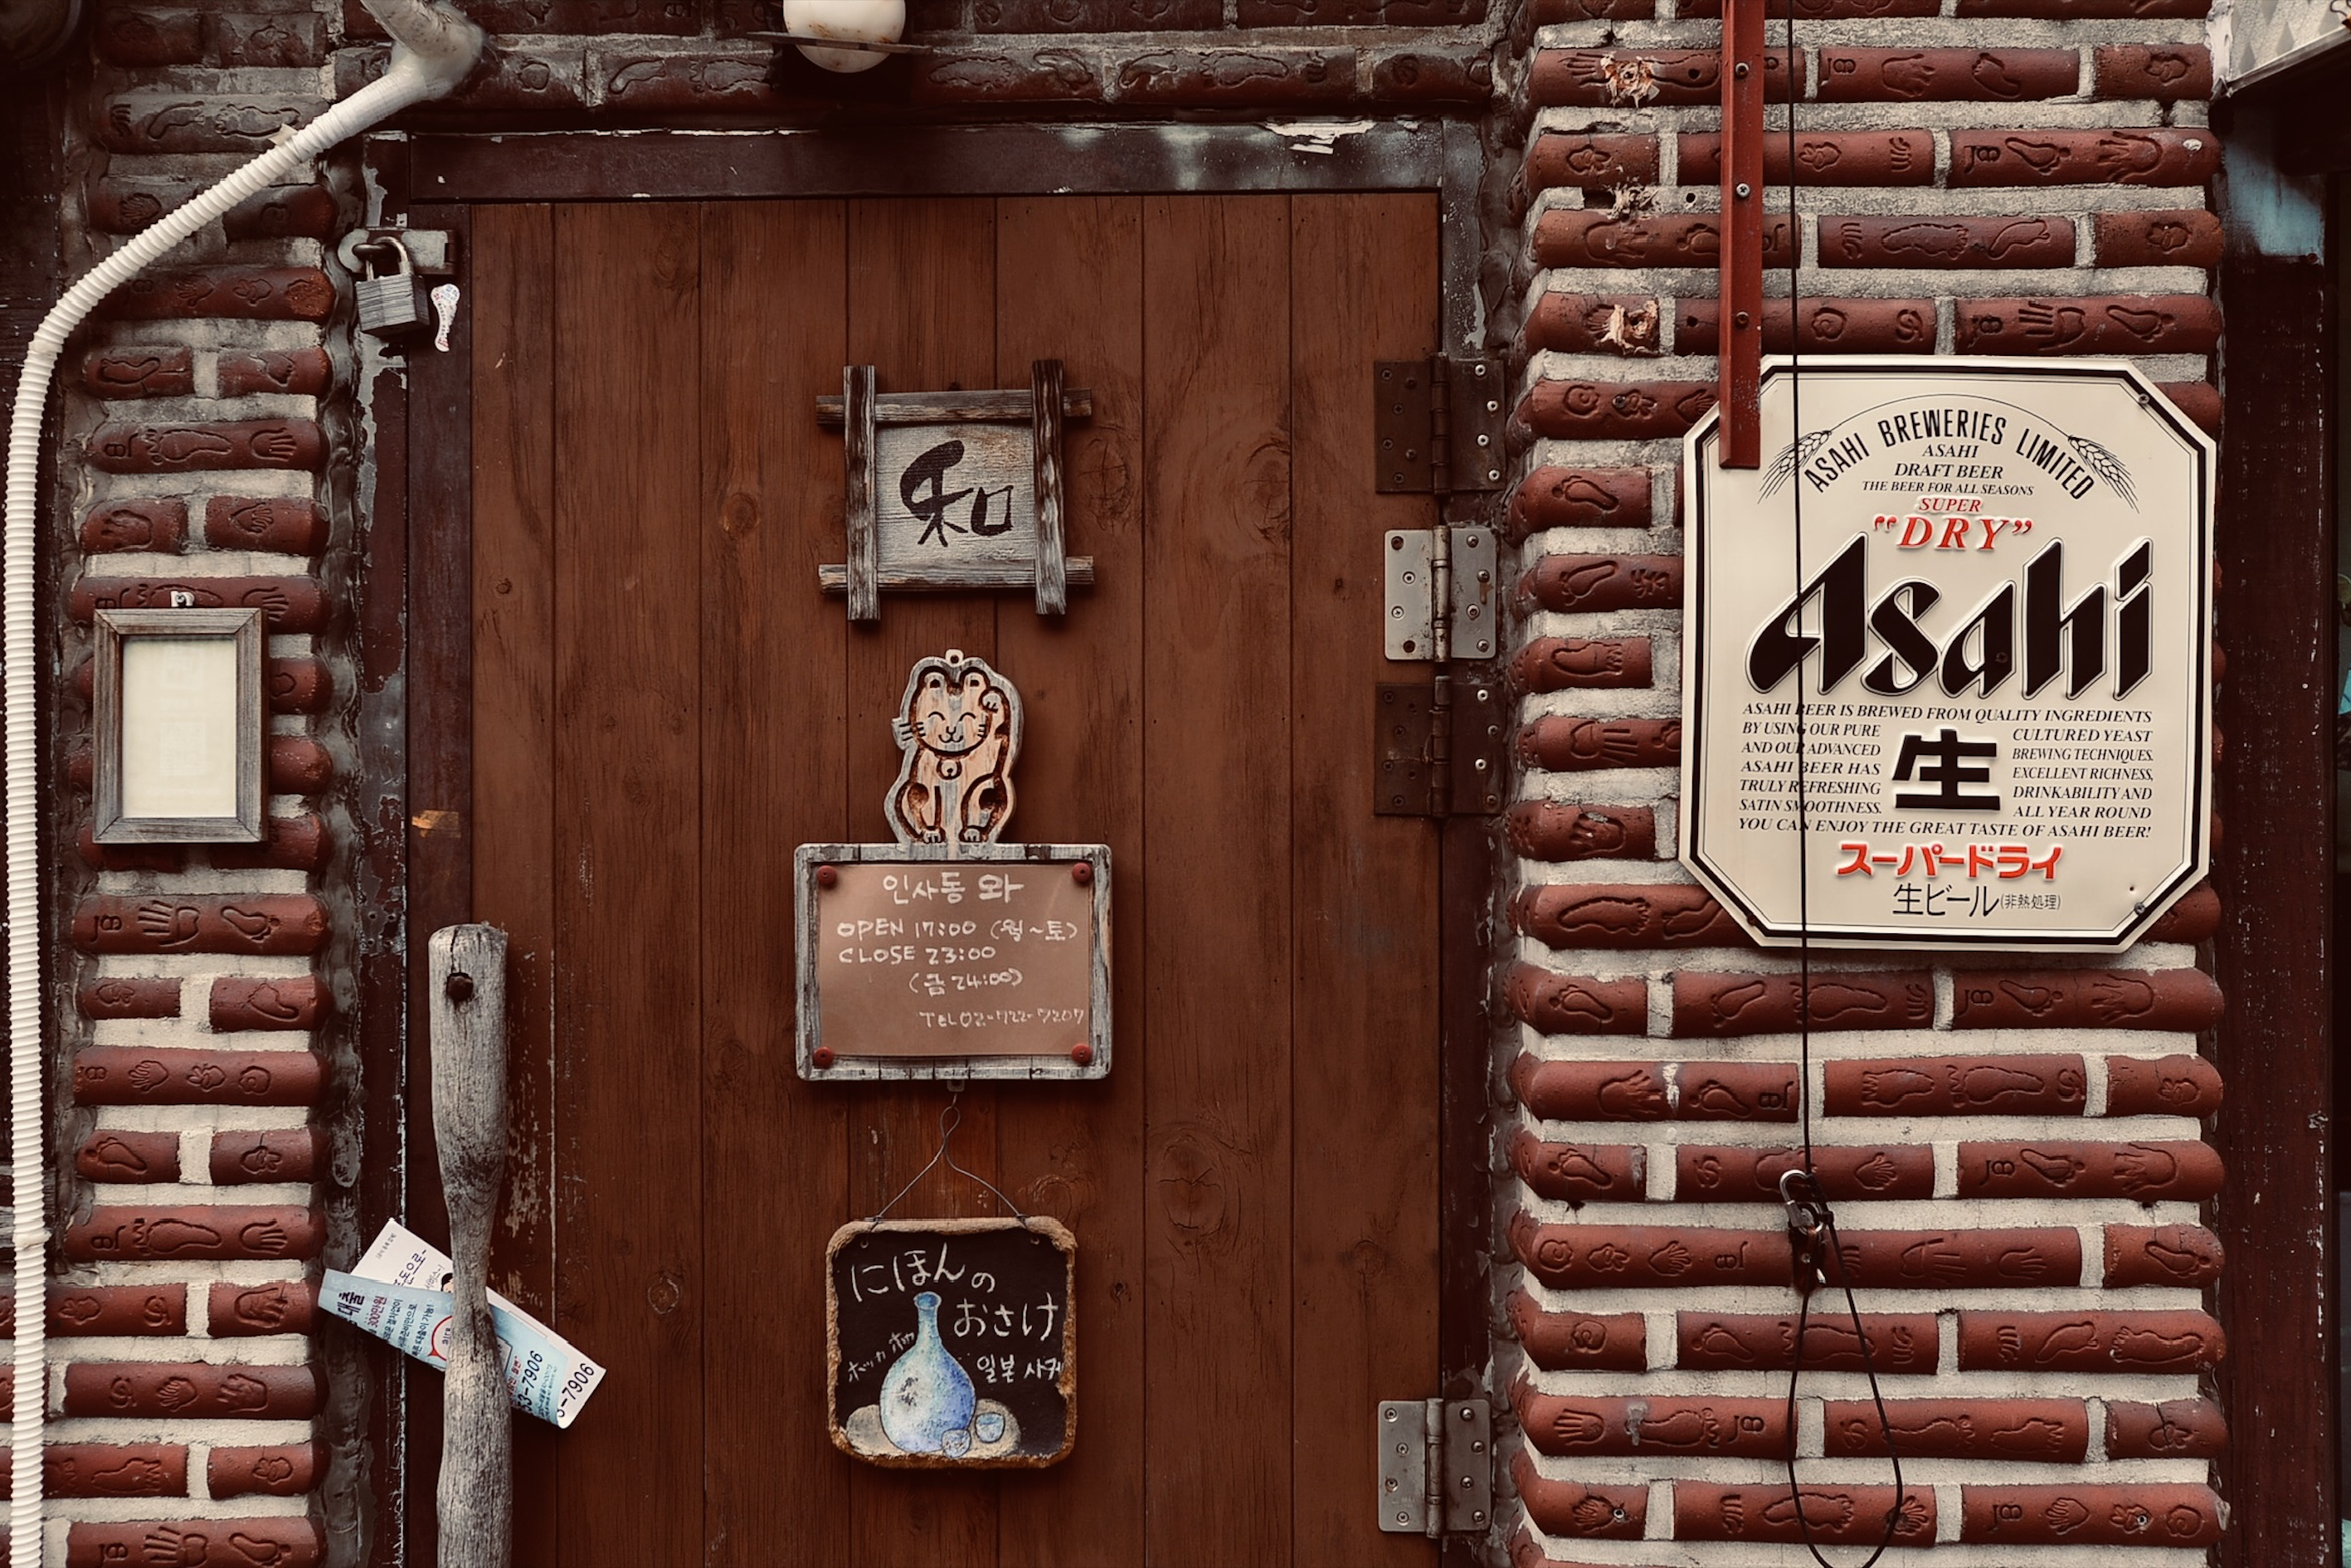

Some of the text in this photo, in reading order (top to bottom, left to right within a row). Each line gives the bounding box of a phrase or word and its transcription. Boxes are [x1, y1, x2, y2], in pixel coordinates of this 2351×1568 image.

[1803, 409, 2095, 499] ASAHI BREWERIES LIMITED
[1922, 444, 1979, 458] ASAHI
[1894, 463, 2003, 479] DRAFT BEER
[899, 440, 1014, 548] 和
[1862, 480, 2034, 496] THE BEER FOR ALL SEASONS
[1918, 498, 1981, 513] SUPER
[1746, 532, 2153, 700] Asahi
[1742, 703, 2152, 723] ASAHI BEER IS BREWED FROM QUALITY INGREDIENTS
[1742, 721, 1881, 737] BY USING OUR PURE
[2013, 728, 2153, 742] CULTURED YEAST
[1741, 742, 1772, 753] AND
[1807, 743, 1881, 756] ADVANCED
[2012, 747, 2071, 760] BREWING
[1740, 760, 1881, 775] ASAHI BEER HAS
[1891, 728, 2000, 811] 生
[2013, 767, 2154, 782] EXCELLENT RICHNESS,
[1740, 779, 1881, 795] TRULY REFRESHING
[2013, 786, 2153, 800] DRINKABILITY AND
[1739, 799, 1782, 811] SATIN
[2013, 806, 2151, 819] ALL YEAR ROUND
[1740, 818, 2151, 838] YOU CAN ENJOY THE GREAT TASTE OF ASAHI BEER!
[1837, 844, 2062, 879] スーパードライ
[883, 871, 1025, 904] 인사동 와
[1892, 883, 1998, 917] 生ビール
[837, 918, 903, 941] OPEN
[915, 920, 976, 939] 17:00
[839, 946, 996, 966] CLOSE 23:00
[851, 1242, 995, 1303] にほんの
[336, 1291, 365, 1317] 대출
[954, 1292, 1059, 1342] おさけ
[976, 1354, 1015, 1384] 일본
